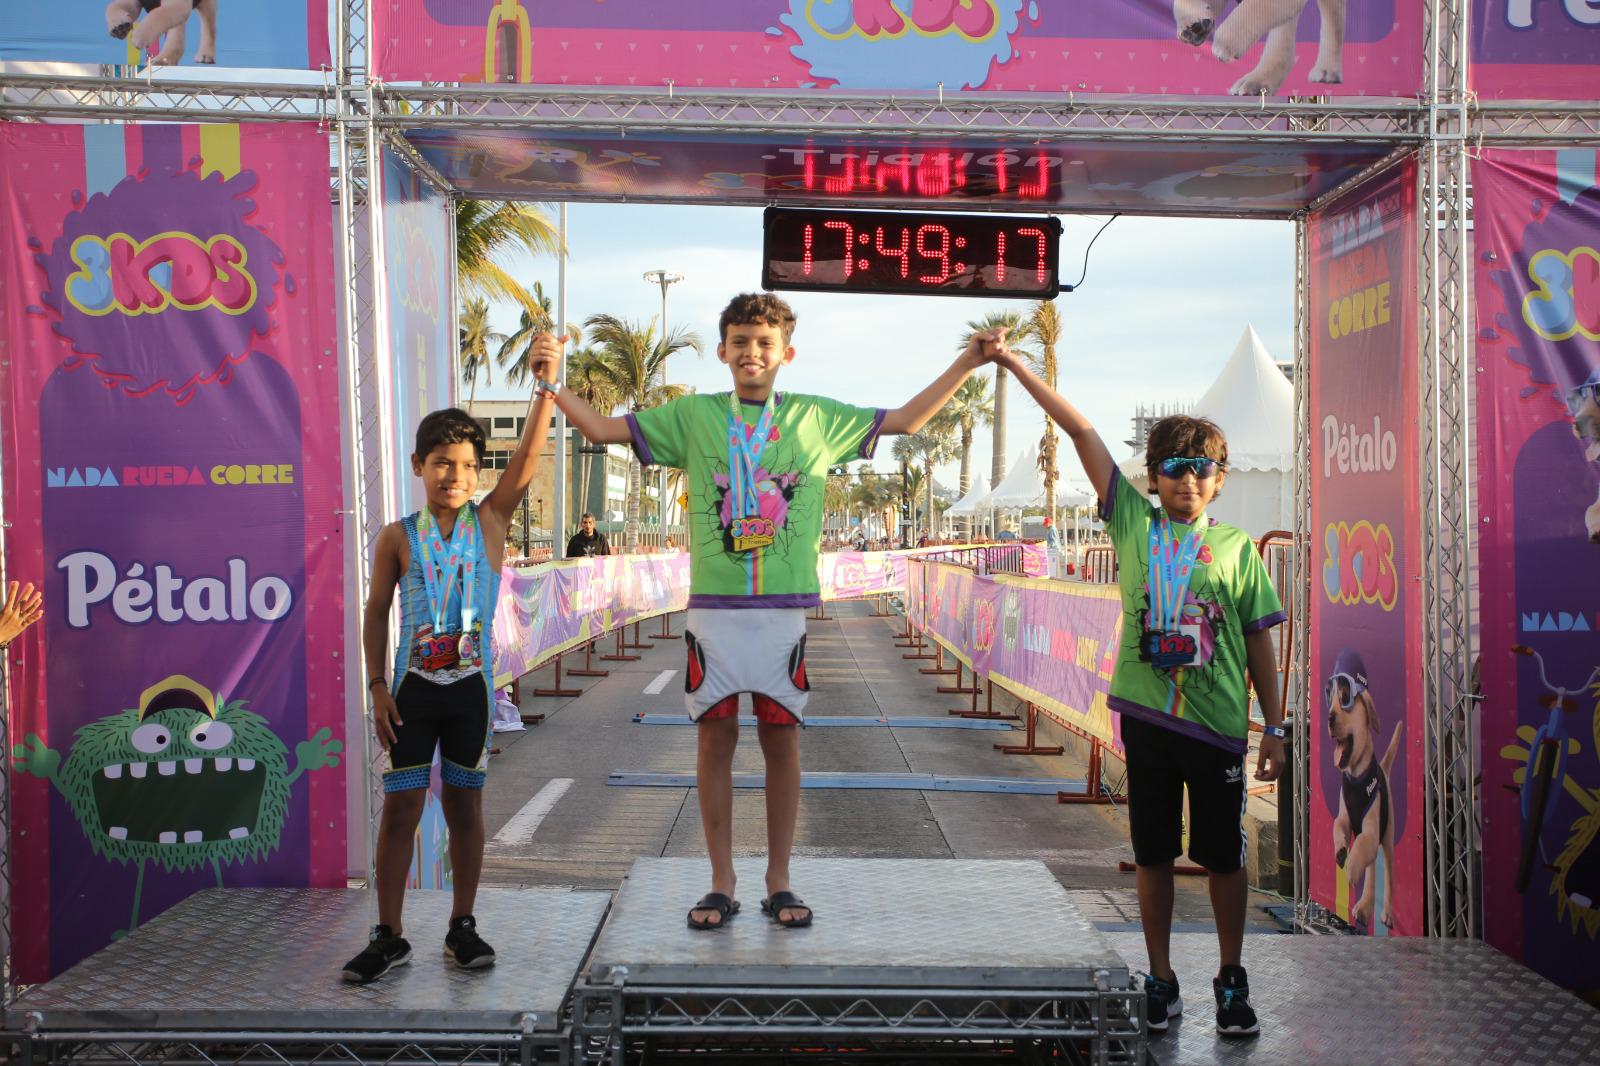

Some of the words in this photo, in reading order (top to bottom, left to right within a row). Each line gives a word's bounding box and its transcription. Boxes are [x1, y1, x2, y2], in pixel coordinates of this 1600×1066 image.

[803, 221, 1047, 284] 17:49:17
[1332, 196, 1386, 259] NADA
[1328, 280, 1391, 341] CORRE
[47, 465, 119, 488] NADA
[122, 465, 207, 487] RUEDA
[210, 463, 294, 486] CORRE
[1322, 414, 1397, 478] Pétalo
[56, 551, 293, 628] Pétalo
[1522, 611, 1591, 632] NADA
